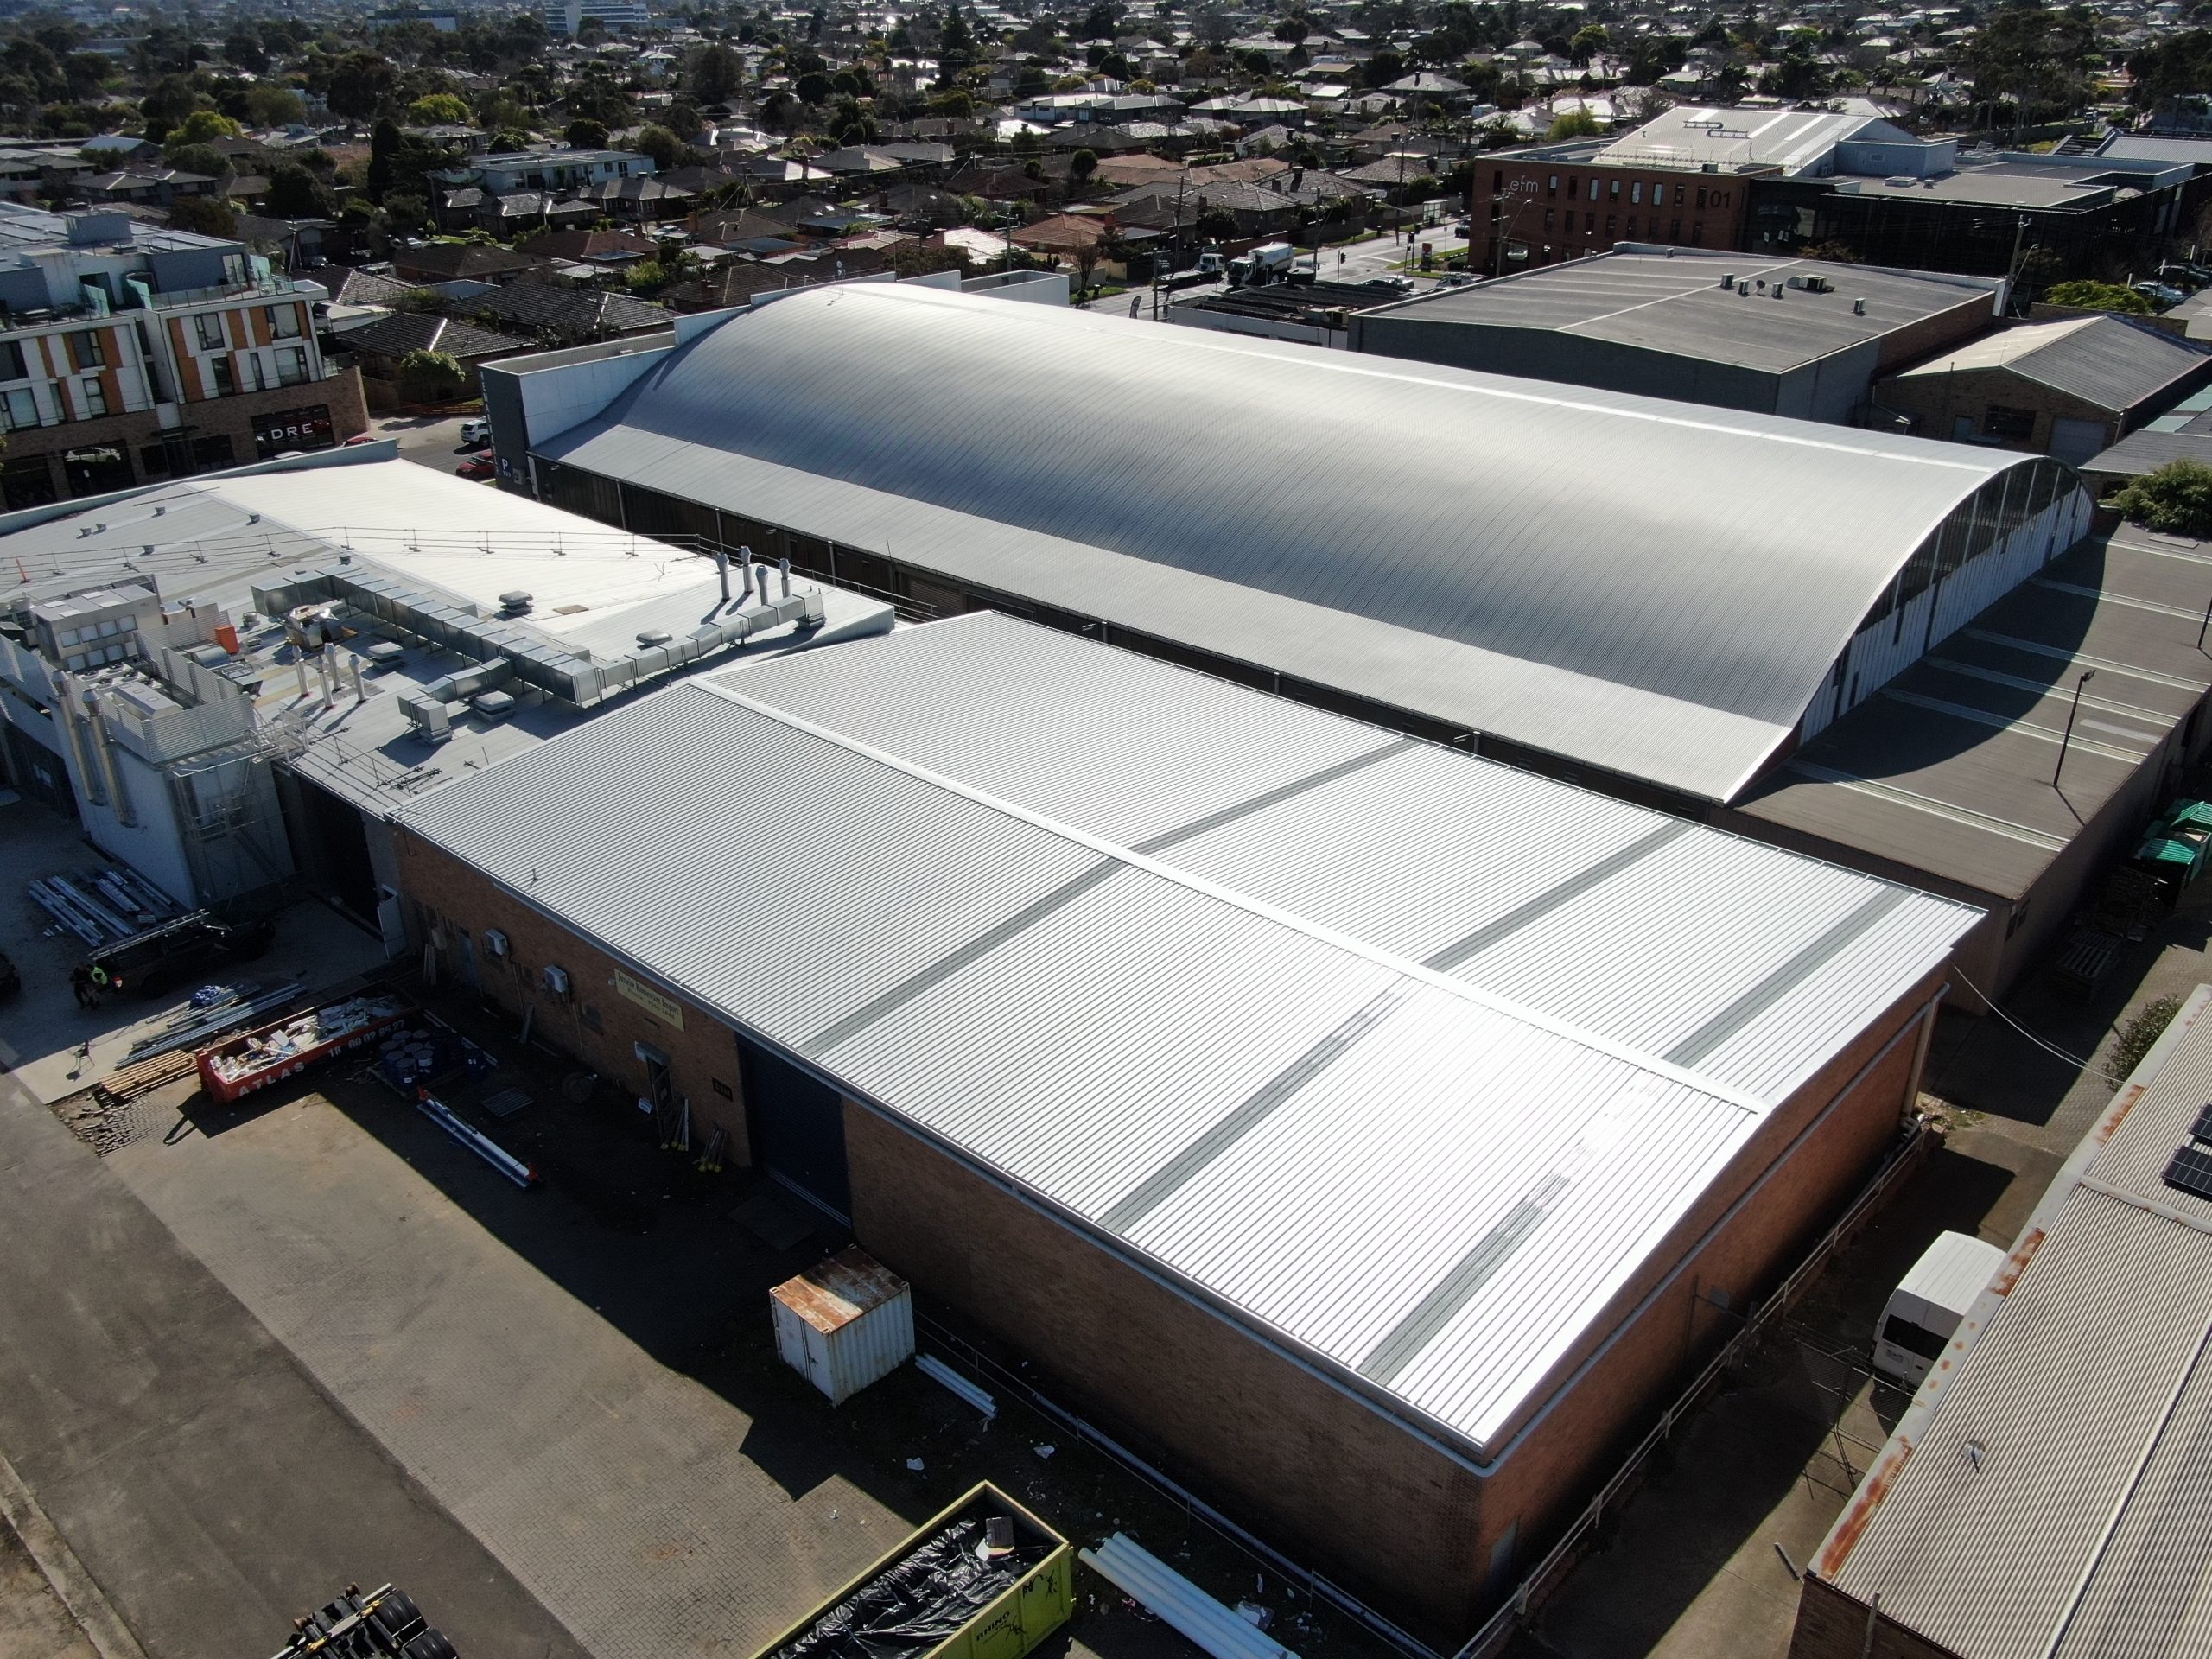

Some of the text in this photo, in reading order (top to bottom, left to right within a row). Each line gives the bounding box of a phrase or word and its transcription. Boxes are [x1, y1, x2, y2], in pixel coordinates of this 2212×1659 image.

[1510, 174, 1538, 193] efm
[270, 423, 314, 440] DRE
[501, 458, 509, 470] P
[238, 1061, 305, 1097] ATLAS
